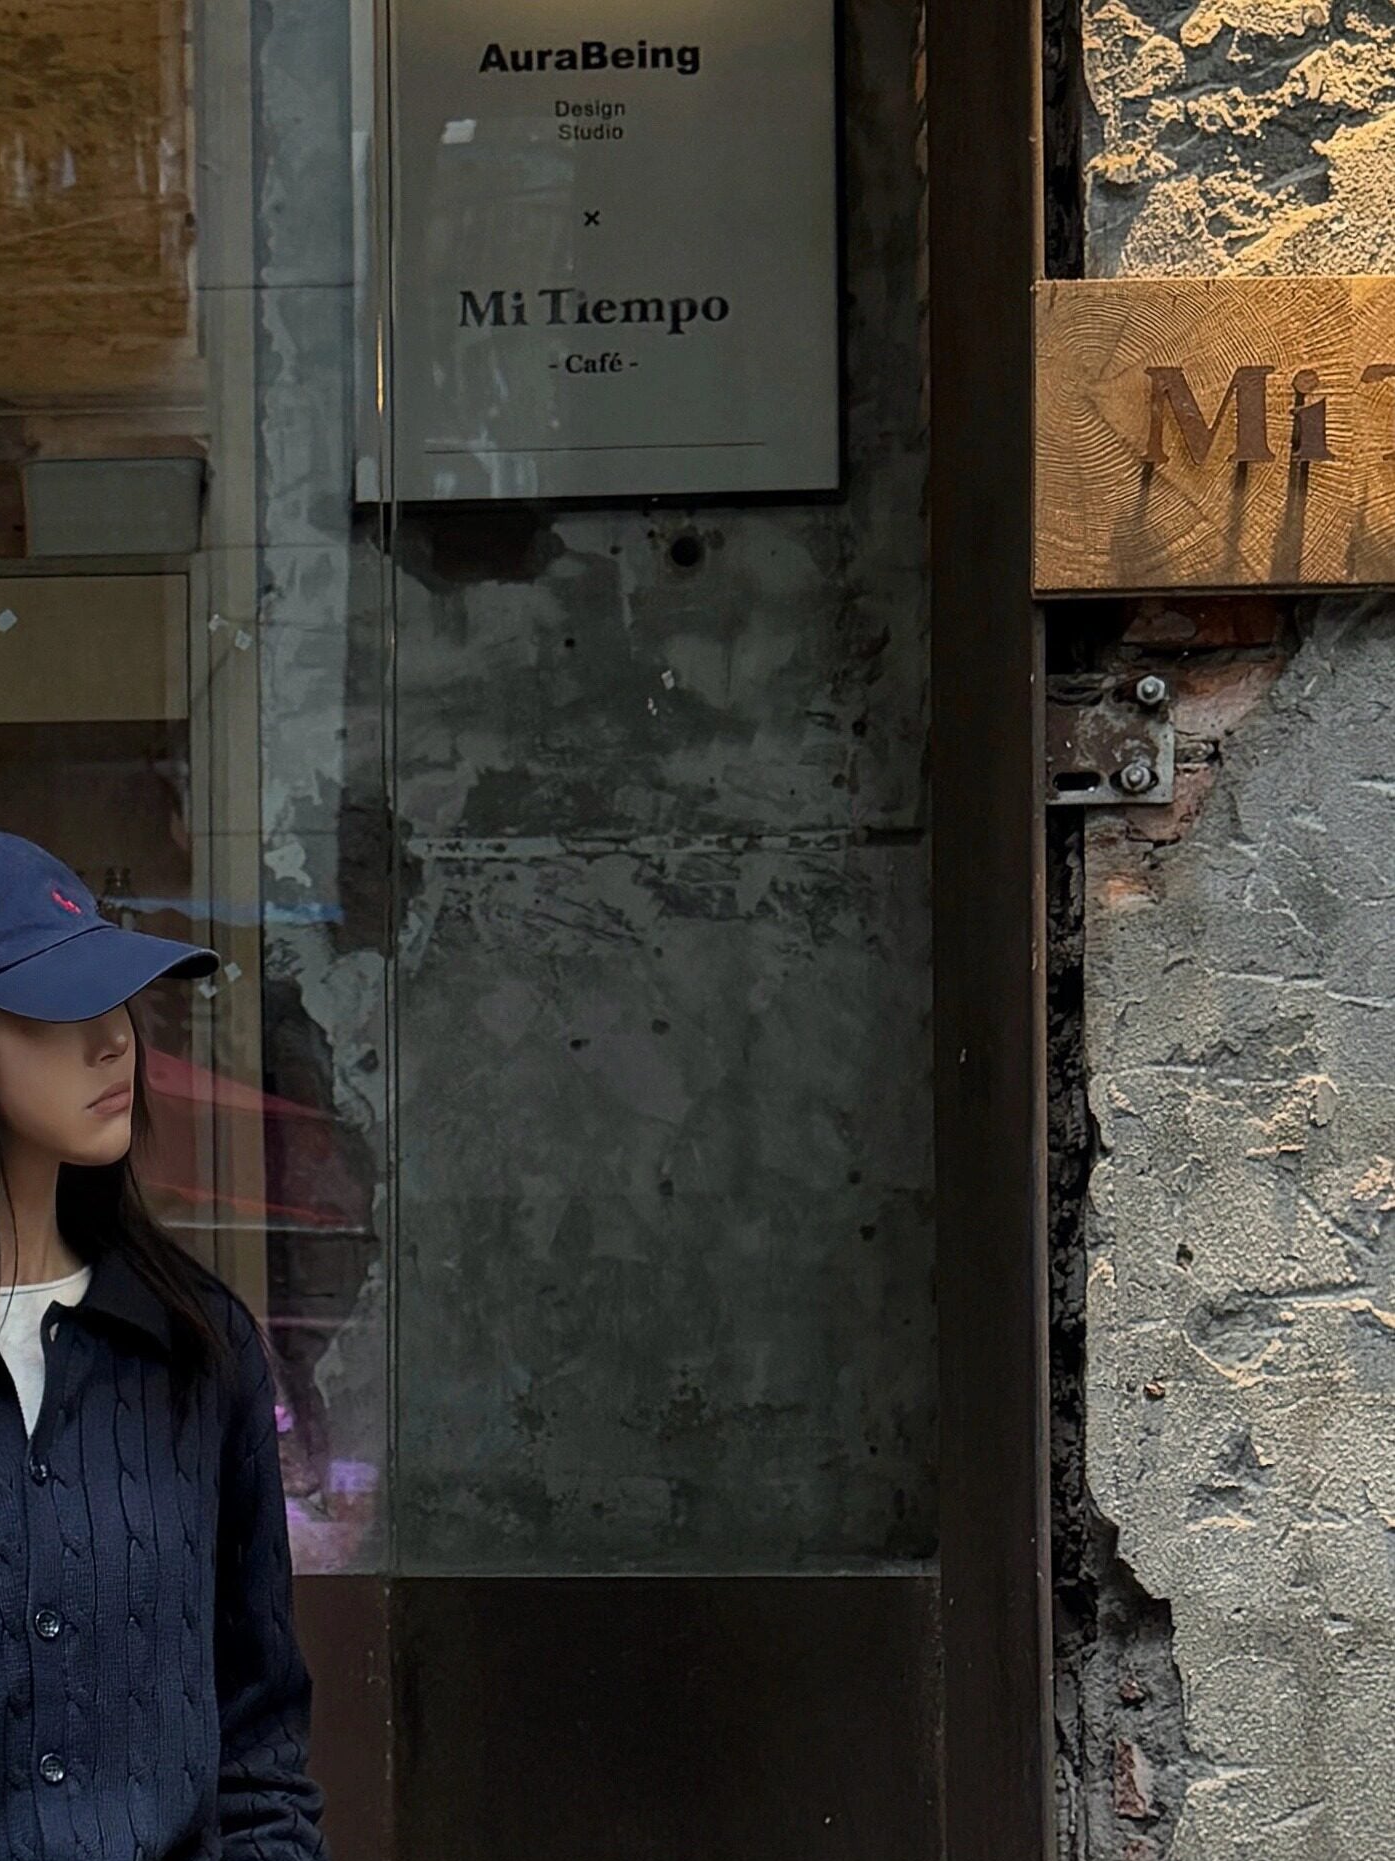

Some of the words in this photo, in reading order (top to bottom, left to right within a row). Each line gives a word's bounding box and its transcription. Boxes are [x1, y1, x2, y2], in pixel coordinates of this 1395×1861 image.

[478, 40, 701, 76] AuraBeing
[555, 100, 626, 120] Design
[557, 123, 624, 141] Studio
[458, 289, 529, 328] Mi
[538, 288, 730, 335] Tiempo
[565, 352, 623, 374] Café
[1140, 365, 1335, 465] Mi
